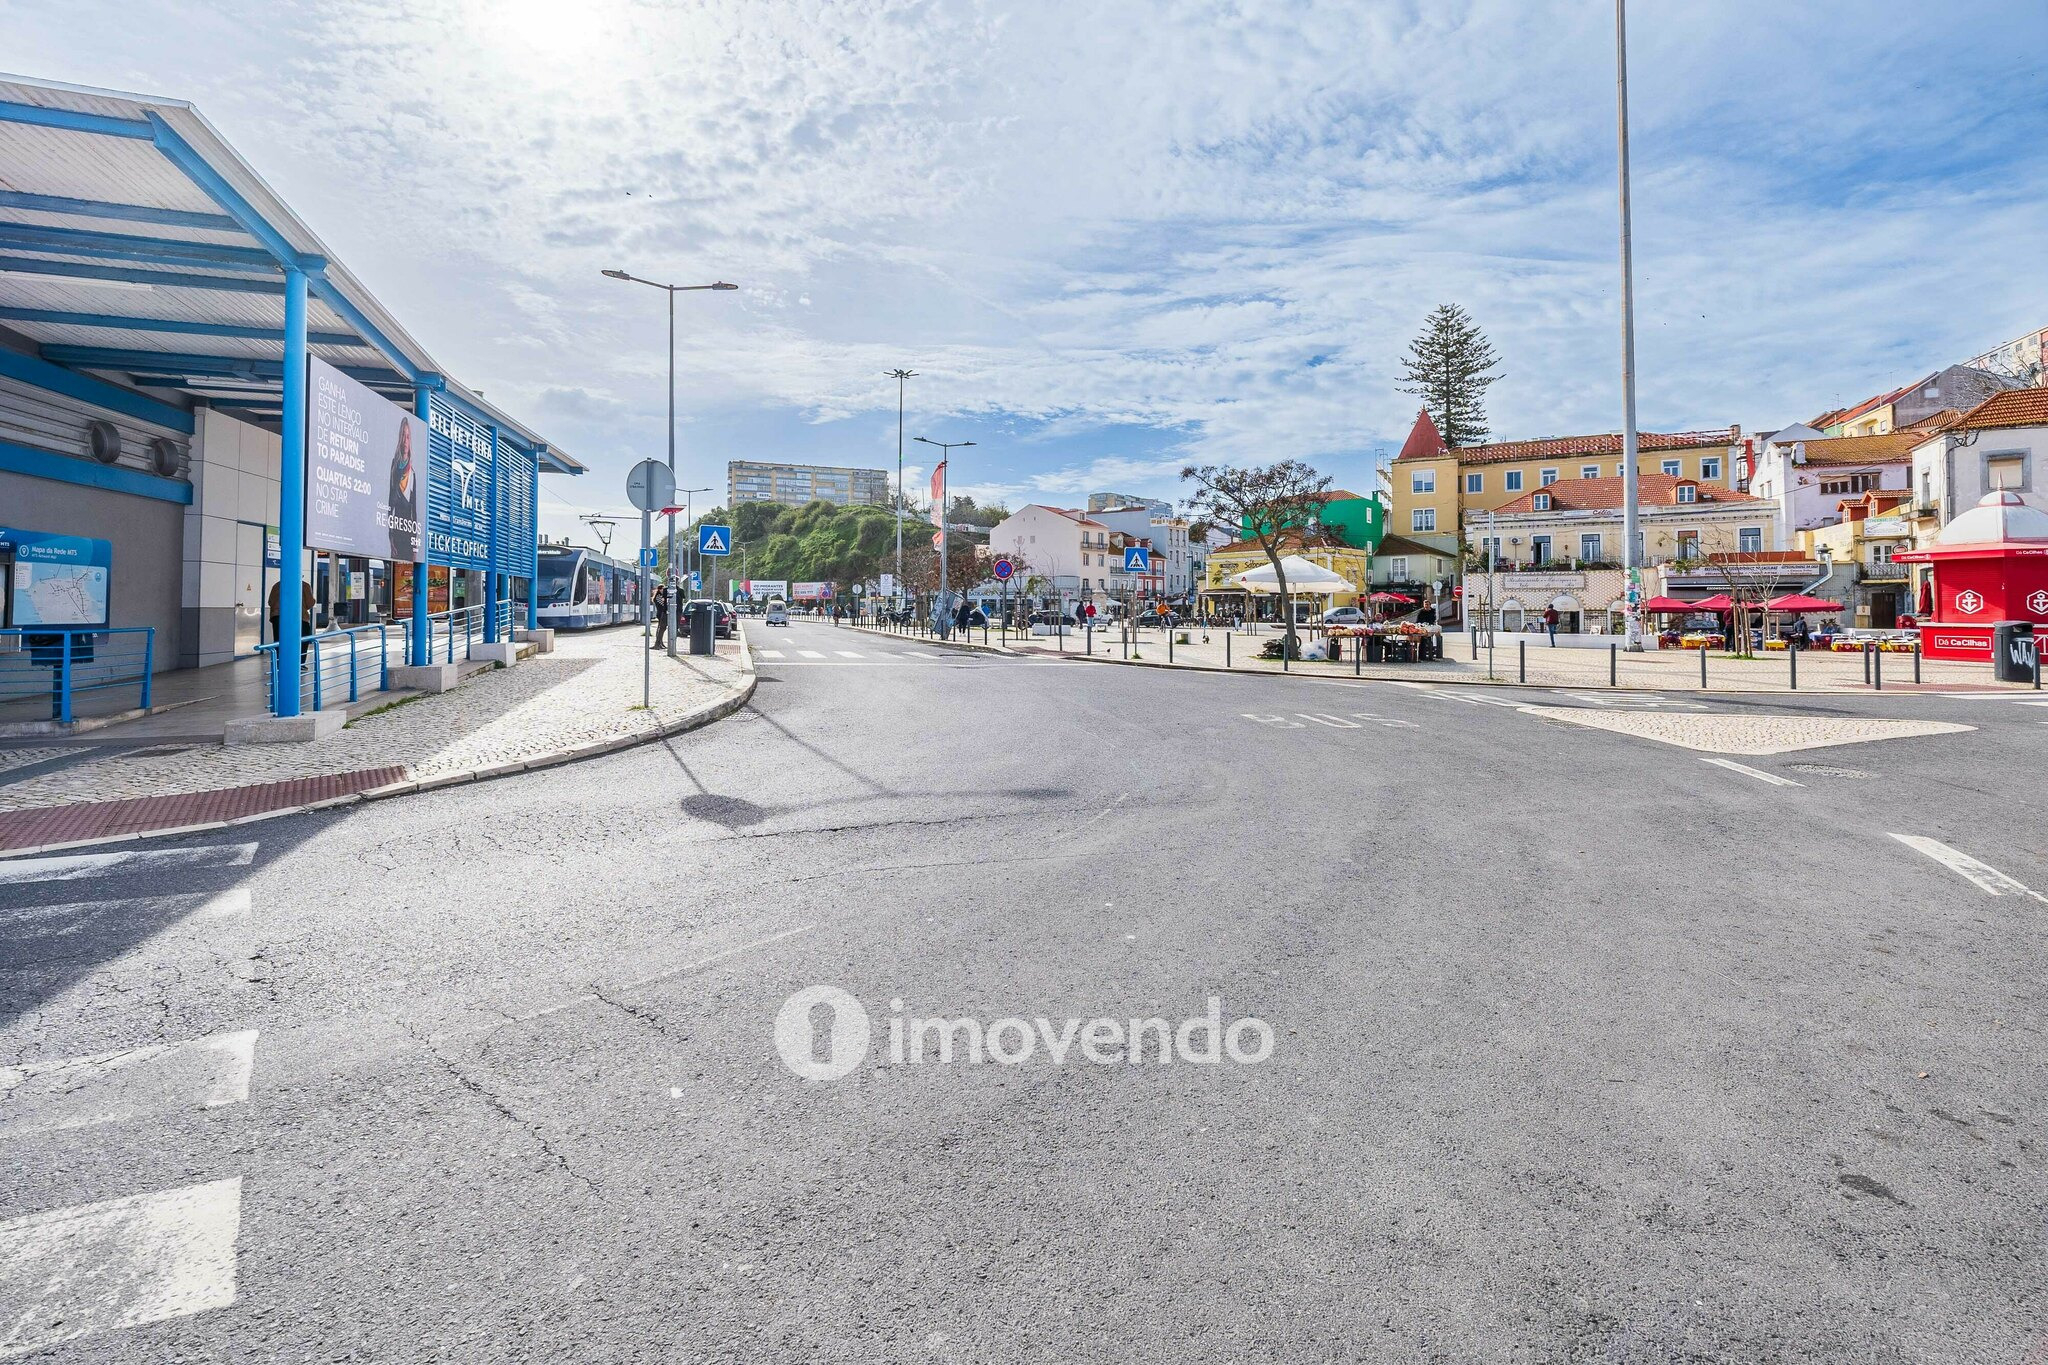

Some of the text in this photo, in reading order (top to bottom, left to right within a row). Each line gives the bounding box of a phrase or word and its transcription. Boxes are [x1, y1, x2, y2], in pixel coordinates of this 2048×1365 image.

[318, 376, 346, 403] GANHA
[318, 392, 362, 428] ESTE LENÇO
[317, 408, 369, 444] NO INTERVALO
[430, 408, 493, 461] BILHETEIRA
[317, 425, 360, 456] DE RETURN
[316, 442, 365, 473] TO PARADISE
[316, 465, 372, 496] QUARTAS 22:00
[316, 482, 348, 504] NO STAR
[315, 499, 340, 518] CRIME
[466, 494, 487, 514] MTS
[31, 546, 46, 556] Mapa
[54, 547, 67, 555] Rede
[428, 531, 488, 559] TICKET OFFICE
[1950, 639, 1988, 647] CaCilhas
